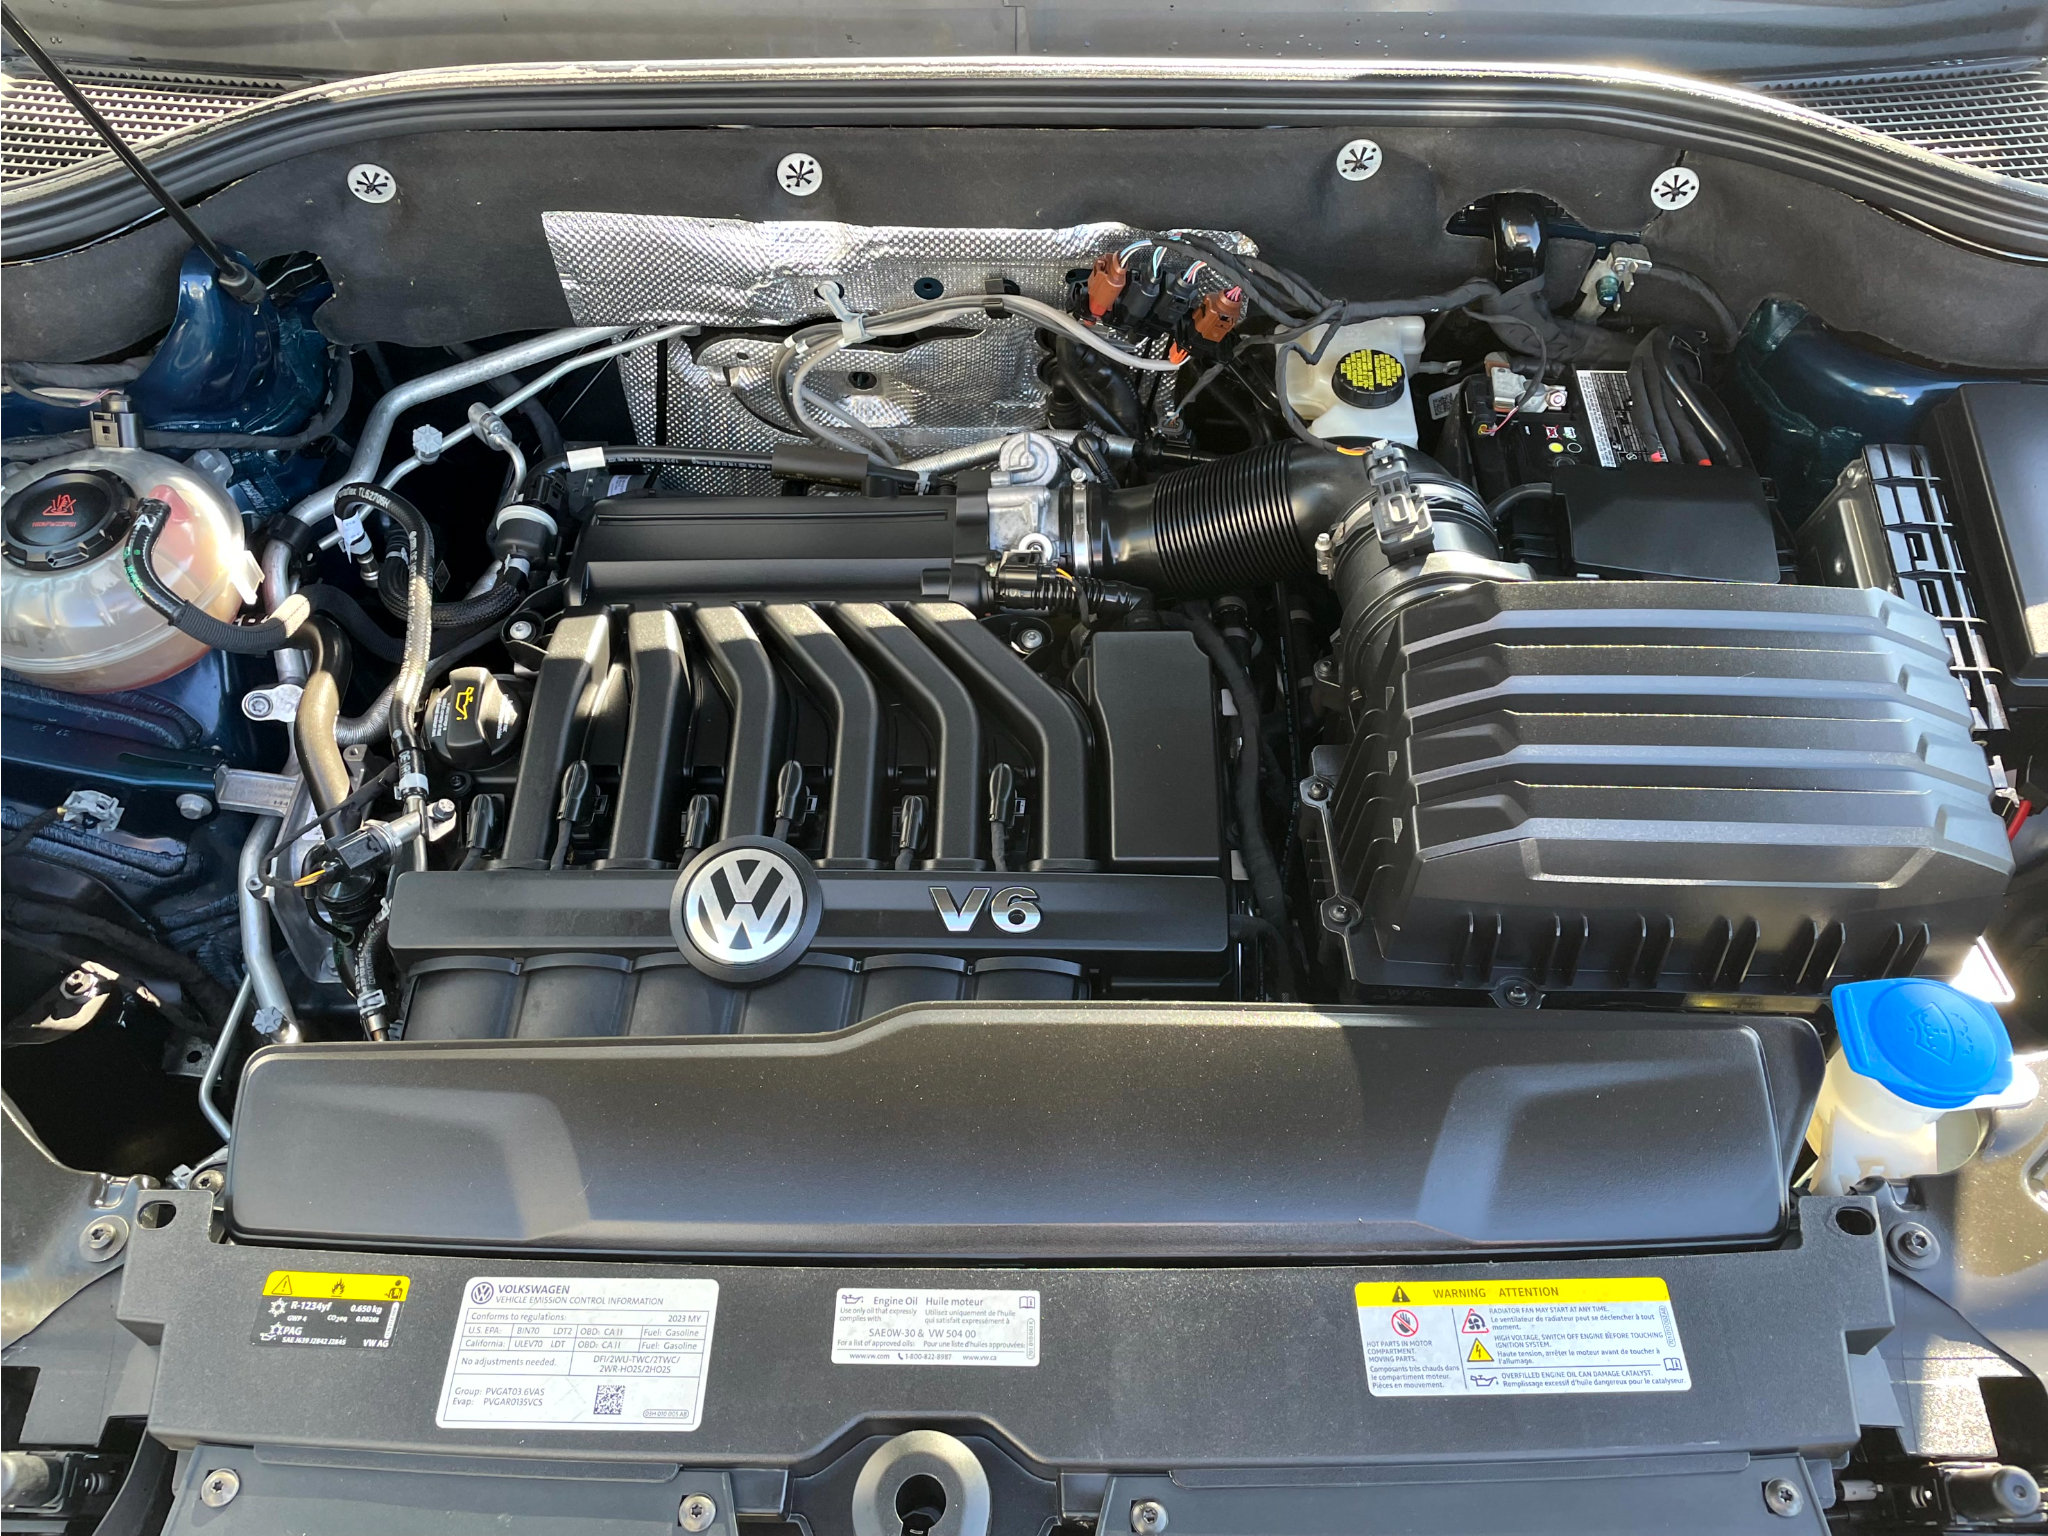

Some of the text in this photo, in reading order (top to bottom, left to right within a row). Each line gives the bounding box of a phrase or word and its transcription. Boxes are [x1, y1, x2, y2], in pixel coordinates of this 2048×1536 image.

[683, 848, 804, 964] VW
[929, 886, 1042, 933] V6
[498, 1284, 570, 1294] VOLKSWAGEN
[1433, 1286, 1560, 1299] WARNING ATTENTION
[496, 1295, 664, 1305] VEHICLE EMISSION CONTROL INFORMATION
[873, 1296, 918, 1307] Engine Oil
[926, 1297, 984, 1306] Huile moteur
[290, 1301, 383, 1315] R-1234yf 0.650 kg
[852, 1307, 866, 1315] only
[889, 1308, 917, 1316] expressly
[949, 1309, 987, 1317] uniquement
[471, 1312, 508, 1320] Conforms
[521, 1312, 566, 1322] regulations:
[668, 1315, 686, 1323] 2023
[688, 1315, 702, 1323] MY
[961, 1317, 1005, 1326] expressément
[283, 1326, 303, 1335] PAG
[516, 1327, 540, 1335] BIN70
[553, 1327, 573, 1335] LDT2
[580, 1327, 600, 1335] OBD:
[604, 1328, 615, 1336] CA
[643, 1328, 662, 1336] Fuel:
[665, 1328, 699, 1337] Gasoline
[869, 1328, 977, 1339] SAE0W-30 & VW 504 00
[1580, 1332, 1604, 1340] ENGINE
[1605, 1331, 1629, 1339] BEFORE
[1630, 1331, 1663, 1339] TOUCHING
[363, 1339, 376, 1347] VW
[376, 1339, 389, 1347] AG
[465, 1339, 505, 1347] California:
[514, 1339, 543, 1347] ULEV70
[551, 1340, 566, 1348] LDT
[601, 1341, 613, 1349] CA
[641, 1341, 660, 1350] Fuel:
[663, 1341, 698, 1350] Gasoline
[871, 1340, 901, 1348] approved
[924, 1340, 938, 1348] Pour
[951, 1340, 964, 1348] liste
[461, 1357, 557, 1367] No adjustments needed.
[593, 1355, 681, 1364] DFI/2WU-TWC/2TWC/
[905, 1353, 952, 1361] 1-800-822-8987
[599, 1365, 672, 1374] 2WR-HO2S/2HO2S
[1369, 1365, 1408, 1373] Composants
[1378, 1373, 1425, 1381] compartiment
[1502, 1380, 1543, 1388] Remplissage
[1593, 1378, 1628, 1387] dangereux
[454, 1386, 483, 1397] Group:
[452, 1397, 474, 1407] Evap:
